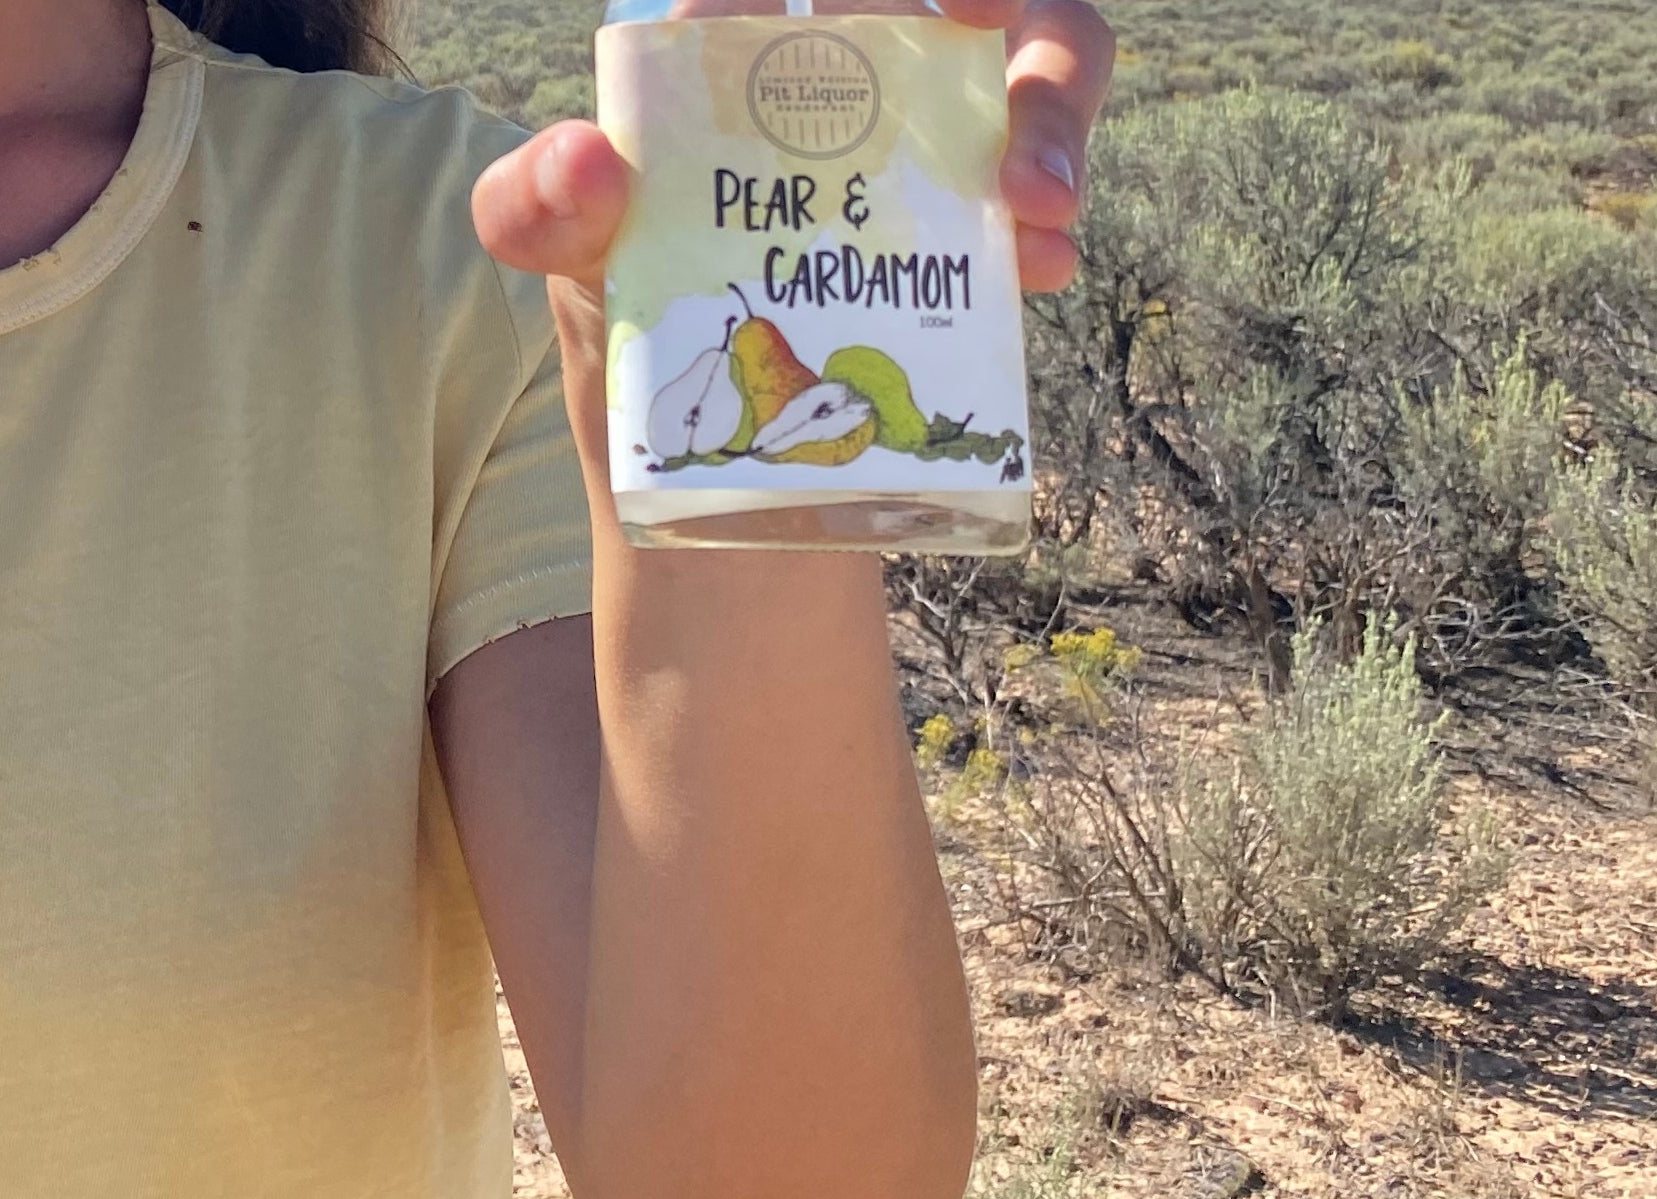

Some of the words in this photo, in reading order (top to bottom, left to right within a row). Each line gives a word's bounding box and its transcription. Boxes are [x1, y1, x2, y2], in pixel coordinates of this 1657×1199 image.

[760, 86, 792, 102] Pit
[798, 85, 869, 105] Liquor
[715, 168, 817, 232] PEAR
[842, 173, 870, 230] &
[764, 245, 971, 310] CARDAMOM
